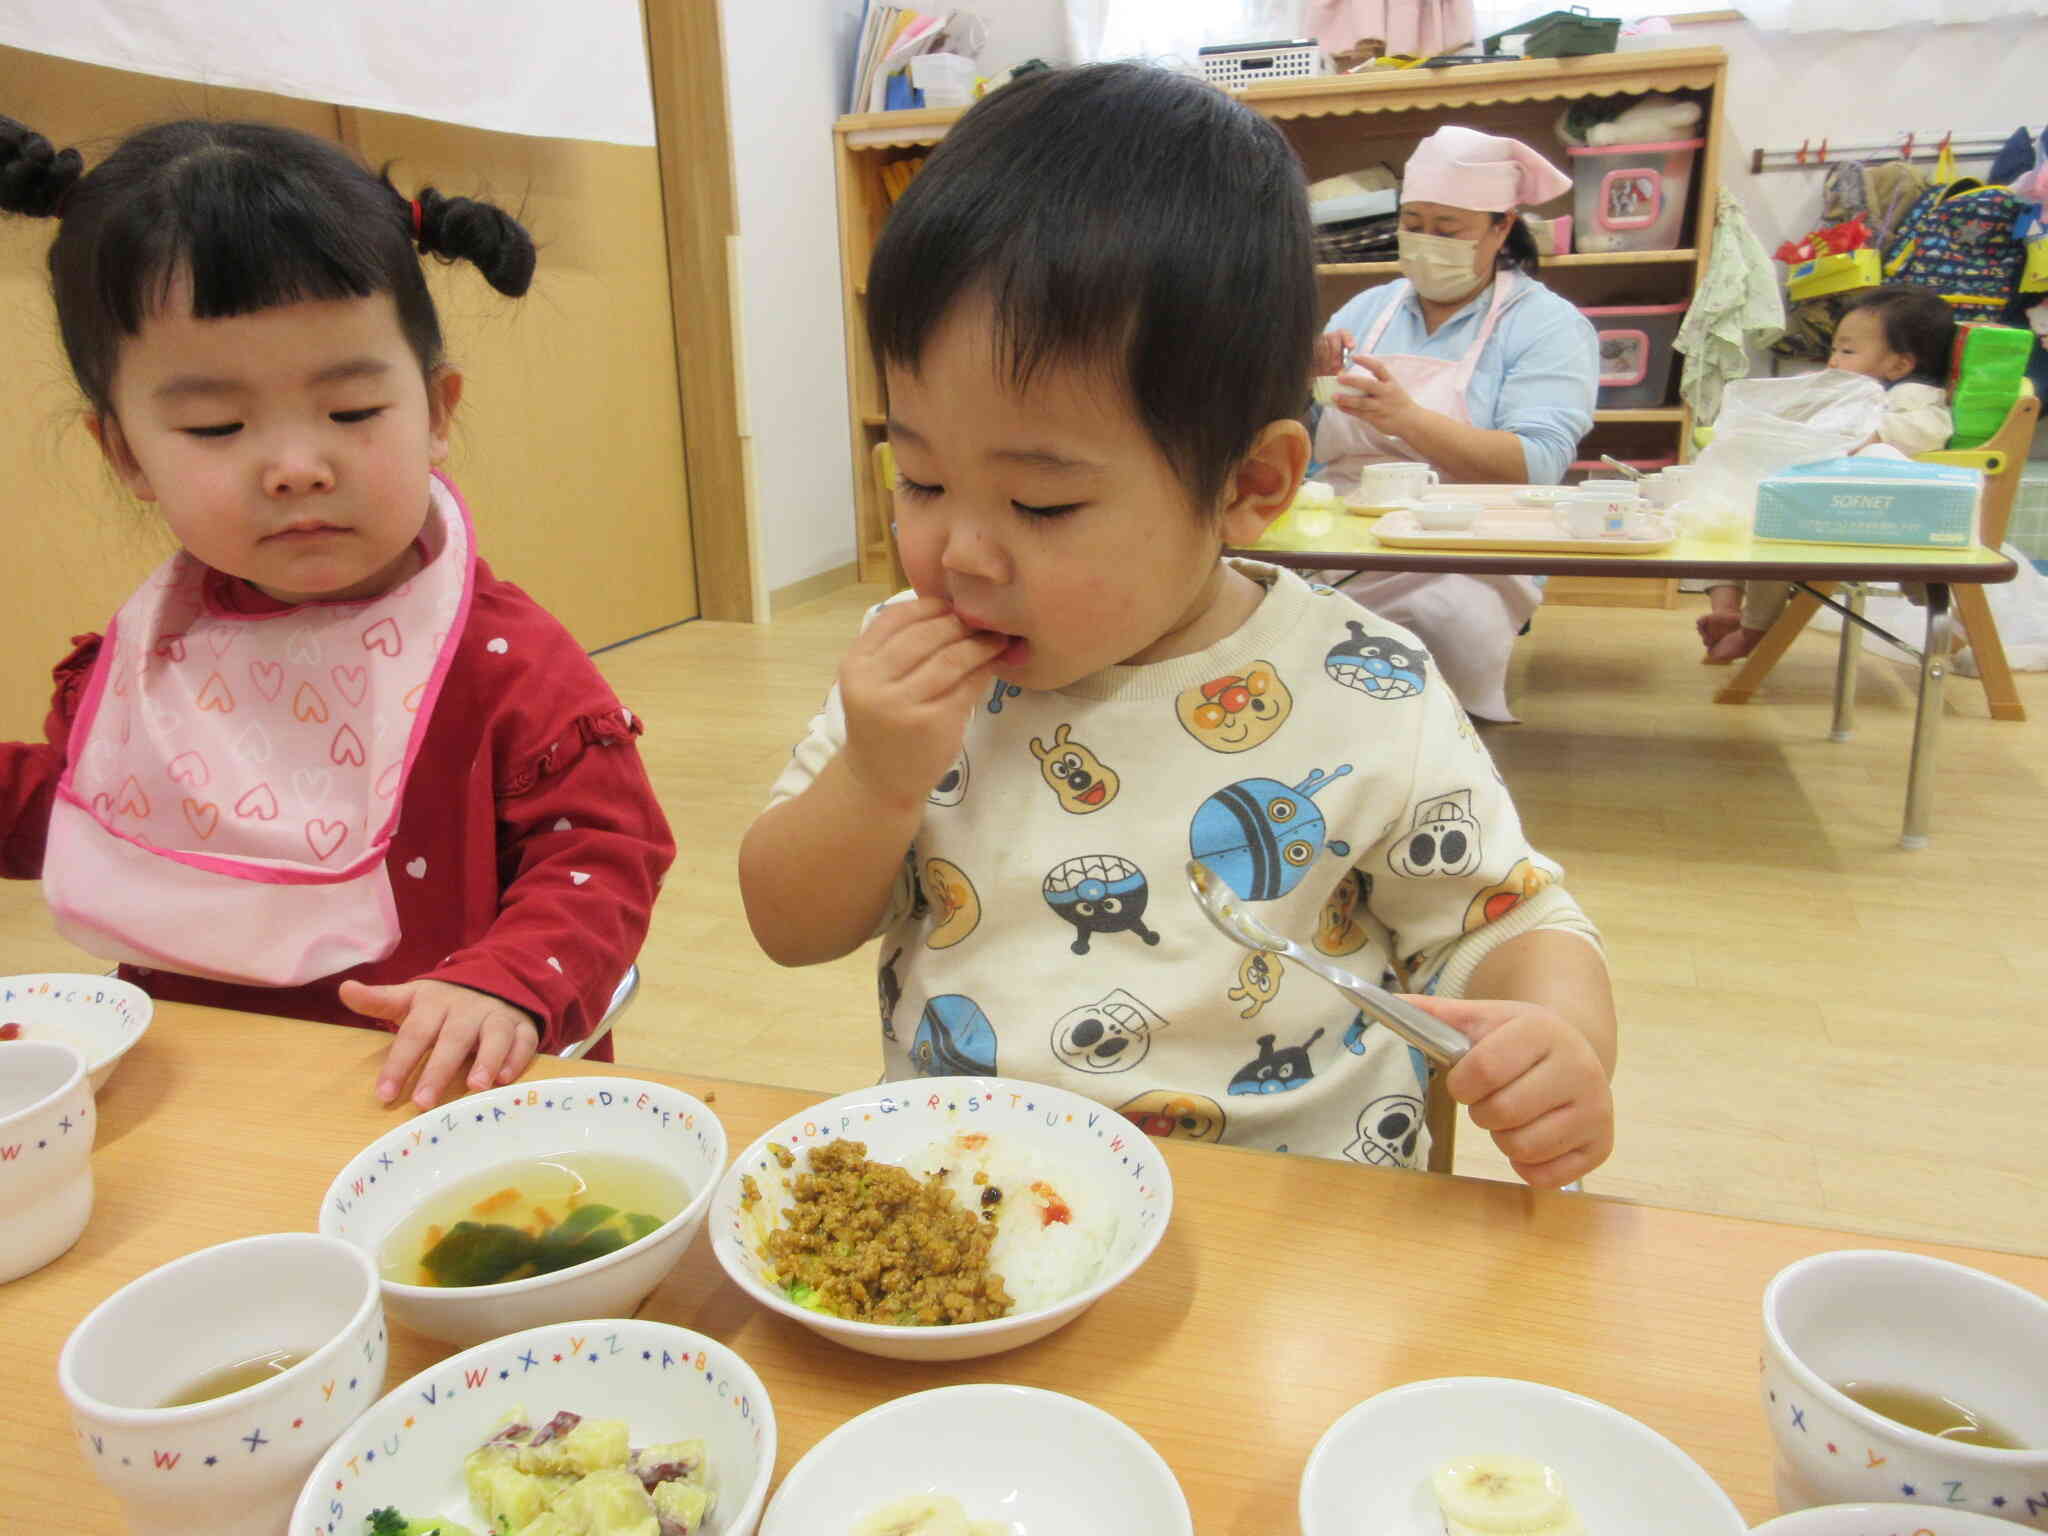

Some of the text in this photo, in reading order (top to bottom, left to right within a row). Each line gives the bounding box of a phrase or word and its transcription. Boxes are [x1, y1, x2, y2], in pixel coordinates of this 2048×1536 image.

[377, 1151, 394, 1172] X
[493, 1107, 506, 1122] A
[527, 1090, 540, 1107] B
[561, 1096, 573, 1111] C
[599, 1091, 613, 1106] D
[662, 1112, 671, 1128] F
[928, 1094, 941, 1110] R
[968, 1097, 980, 1112] S
[1009, 1094, 1023, 1109] T
[1046, 1113, 1059, 1127] U
[1088, 1112, 1101, 1129] V
[153, 1450, 181, 1471] W
[242, 1428, 269, 1453] X
[321, 1379, 335, 1402] Y
[330, 1500, 343, 1520] S
[421, 1383, 436, 1405] V
[464, 1367, 488, 1390] W
[517, 1348, 540, 1373] X
[568, 1336, 587, 1357] Y
[604, 1333, 625, 1355] Z
[662, 1350, 675, 1370] A
[1790, 1404, 1807, 1432] X
[1943, 1480, 1967, 1502] Z
